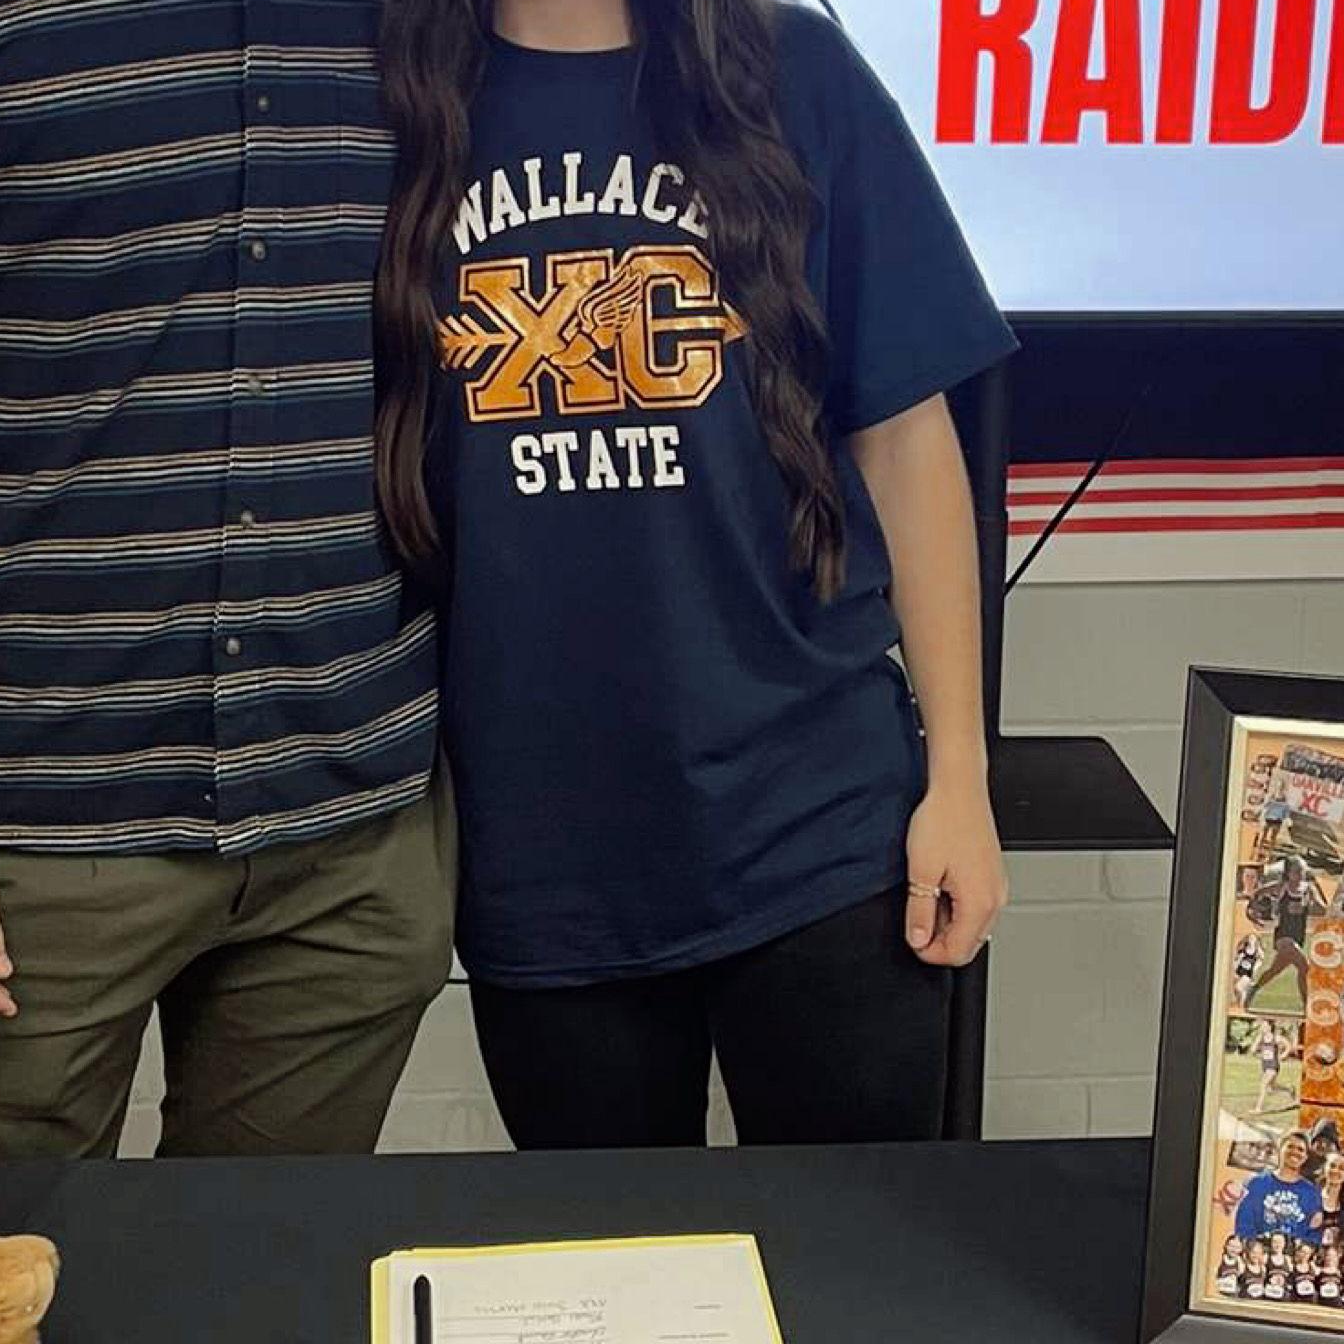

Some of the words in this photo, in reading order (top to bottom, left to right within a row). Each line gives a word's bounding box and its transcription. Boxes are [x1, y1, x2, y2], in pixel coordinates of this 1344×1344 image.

[452, 151, 709, 254] WALLACE
[458, 243, 725, 423] XC
[510, 424, 686, 495] STATE
